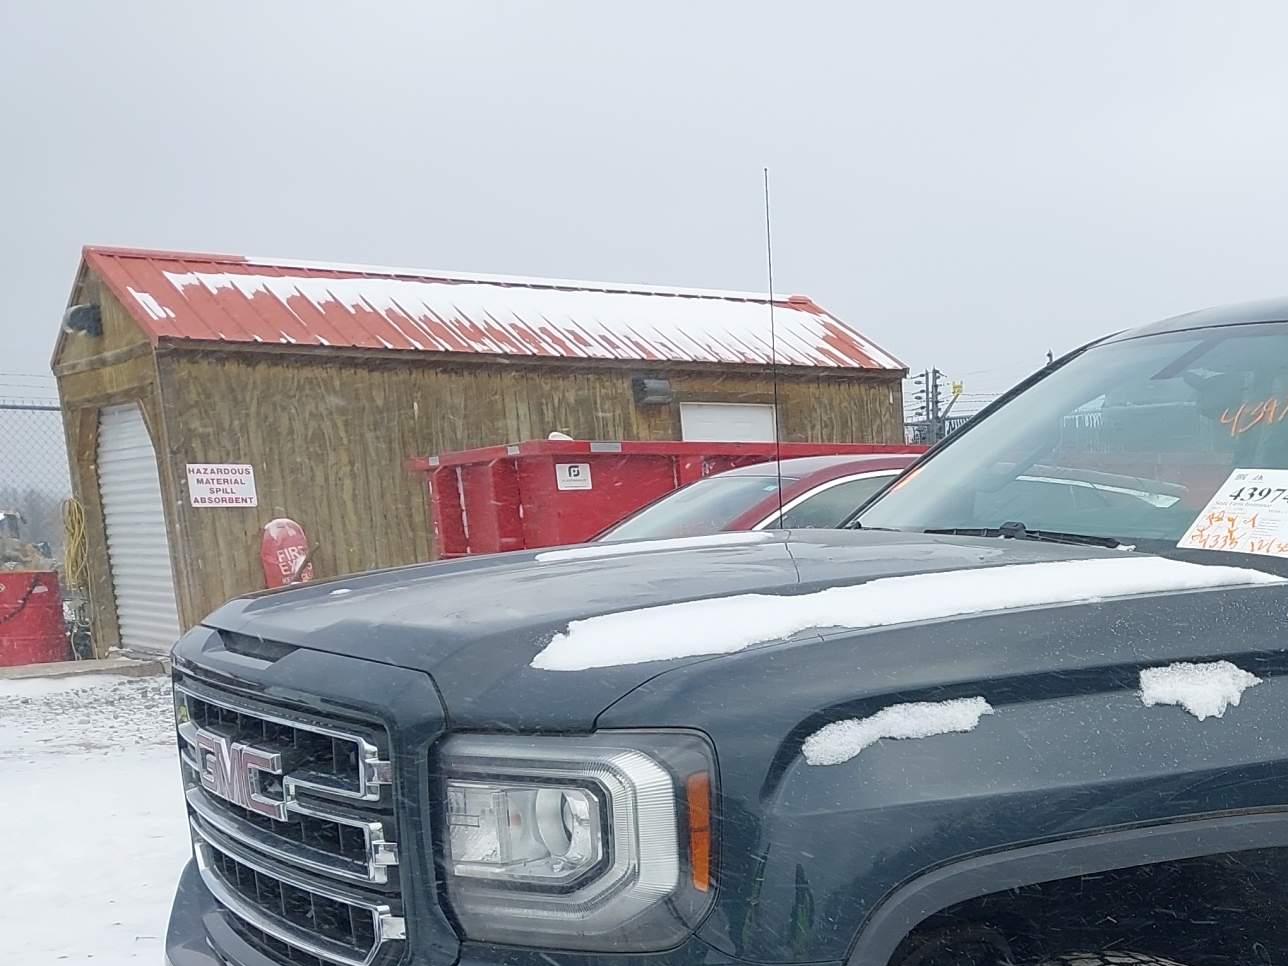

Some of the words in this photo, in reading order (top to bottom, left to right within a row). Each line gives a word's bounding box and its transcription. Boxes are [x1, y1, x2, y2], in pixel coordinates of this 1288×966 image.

[188, 467, 251, 475] HAZARDOUS
[209, 487, 237, 495] SPILL
[193, 496, 254, 504] ABSORBENT
[195, 727, 288, 822] GMC
